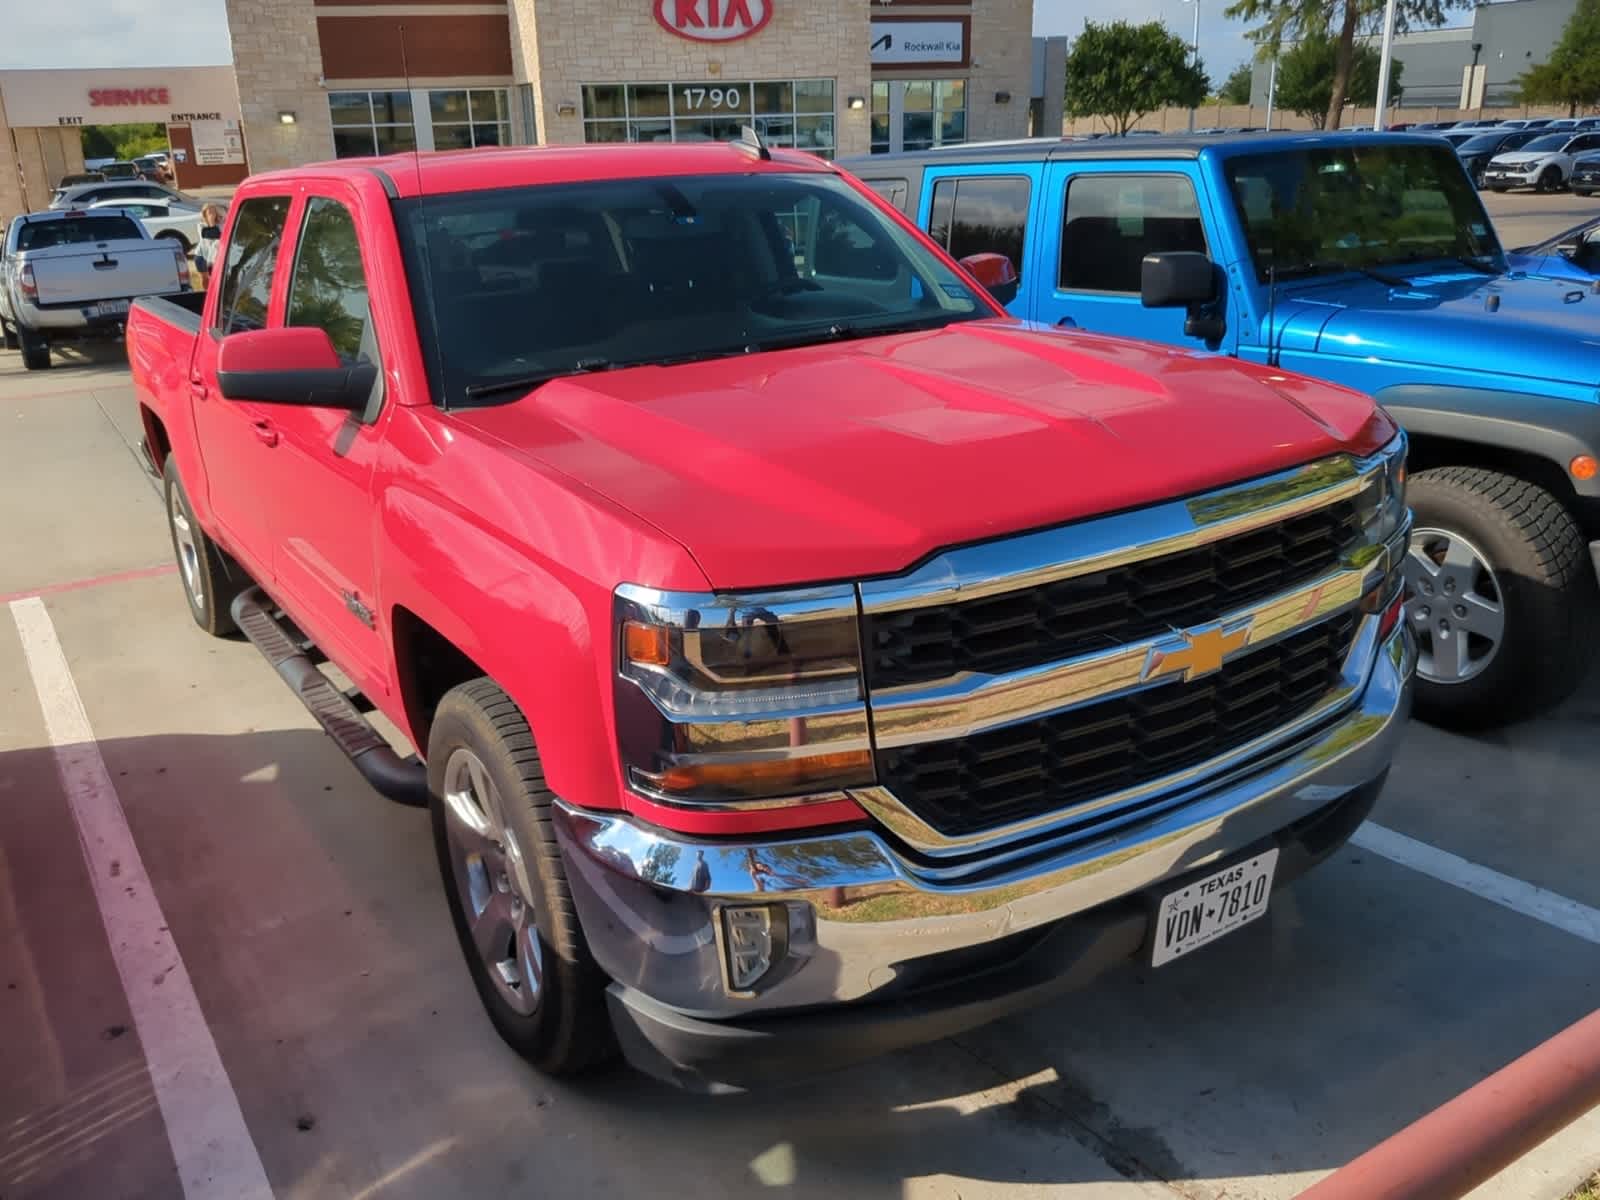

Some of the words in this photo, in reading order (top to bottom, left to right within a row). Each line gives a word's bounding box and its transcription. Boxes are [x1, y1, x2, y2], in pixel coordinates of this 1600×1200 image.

[675, 0, 753, 28] KIA
[904, 41, 944, 52] Rockwall
[946, 40, 961, 51] Kia
[89, 87, 169, 106] SERVICE
[683, 88, 740, 109] 1790
[58, 116, 82, 125] EXIT
[171, 112, 221, 121] ENTRANCE
[1200, 867, 1243, 896] TEXAS
